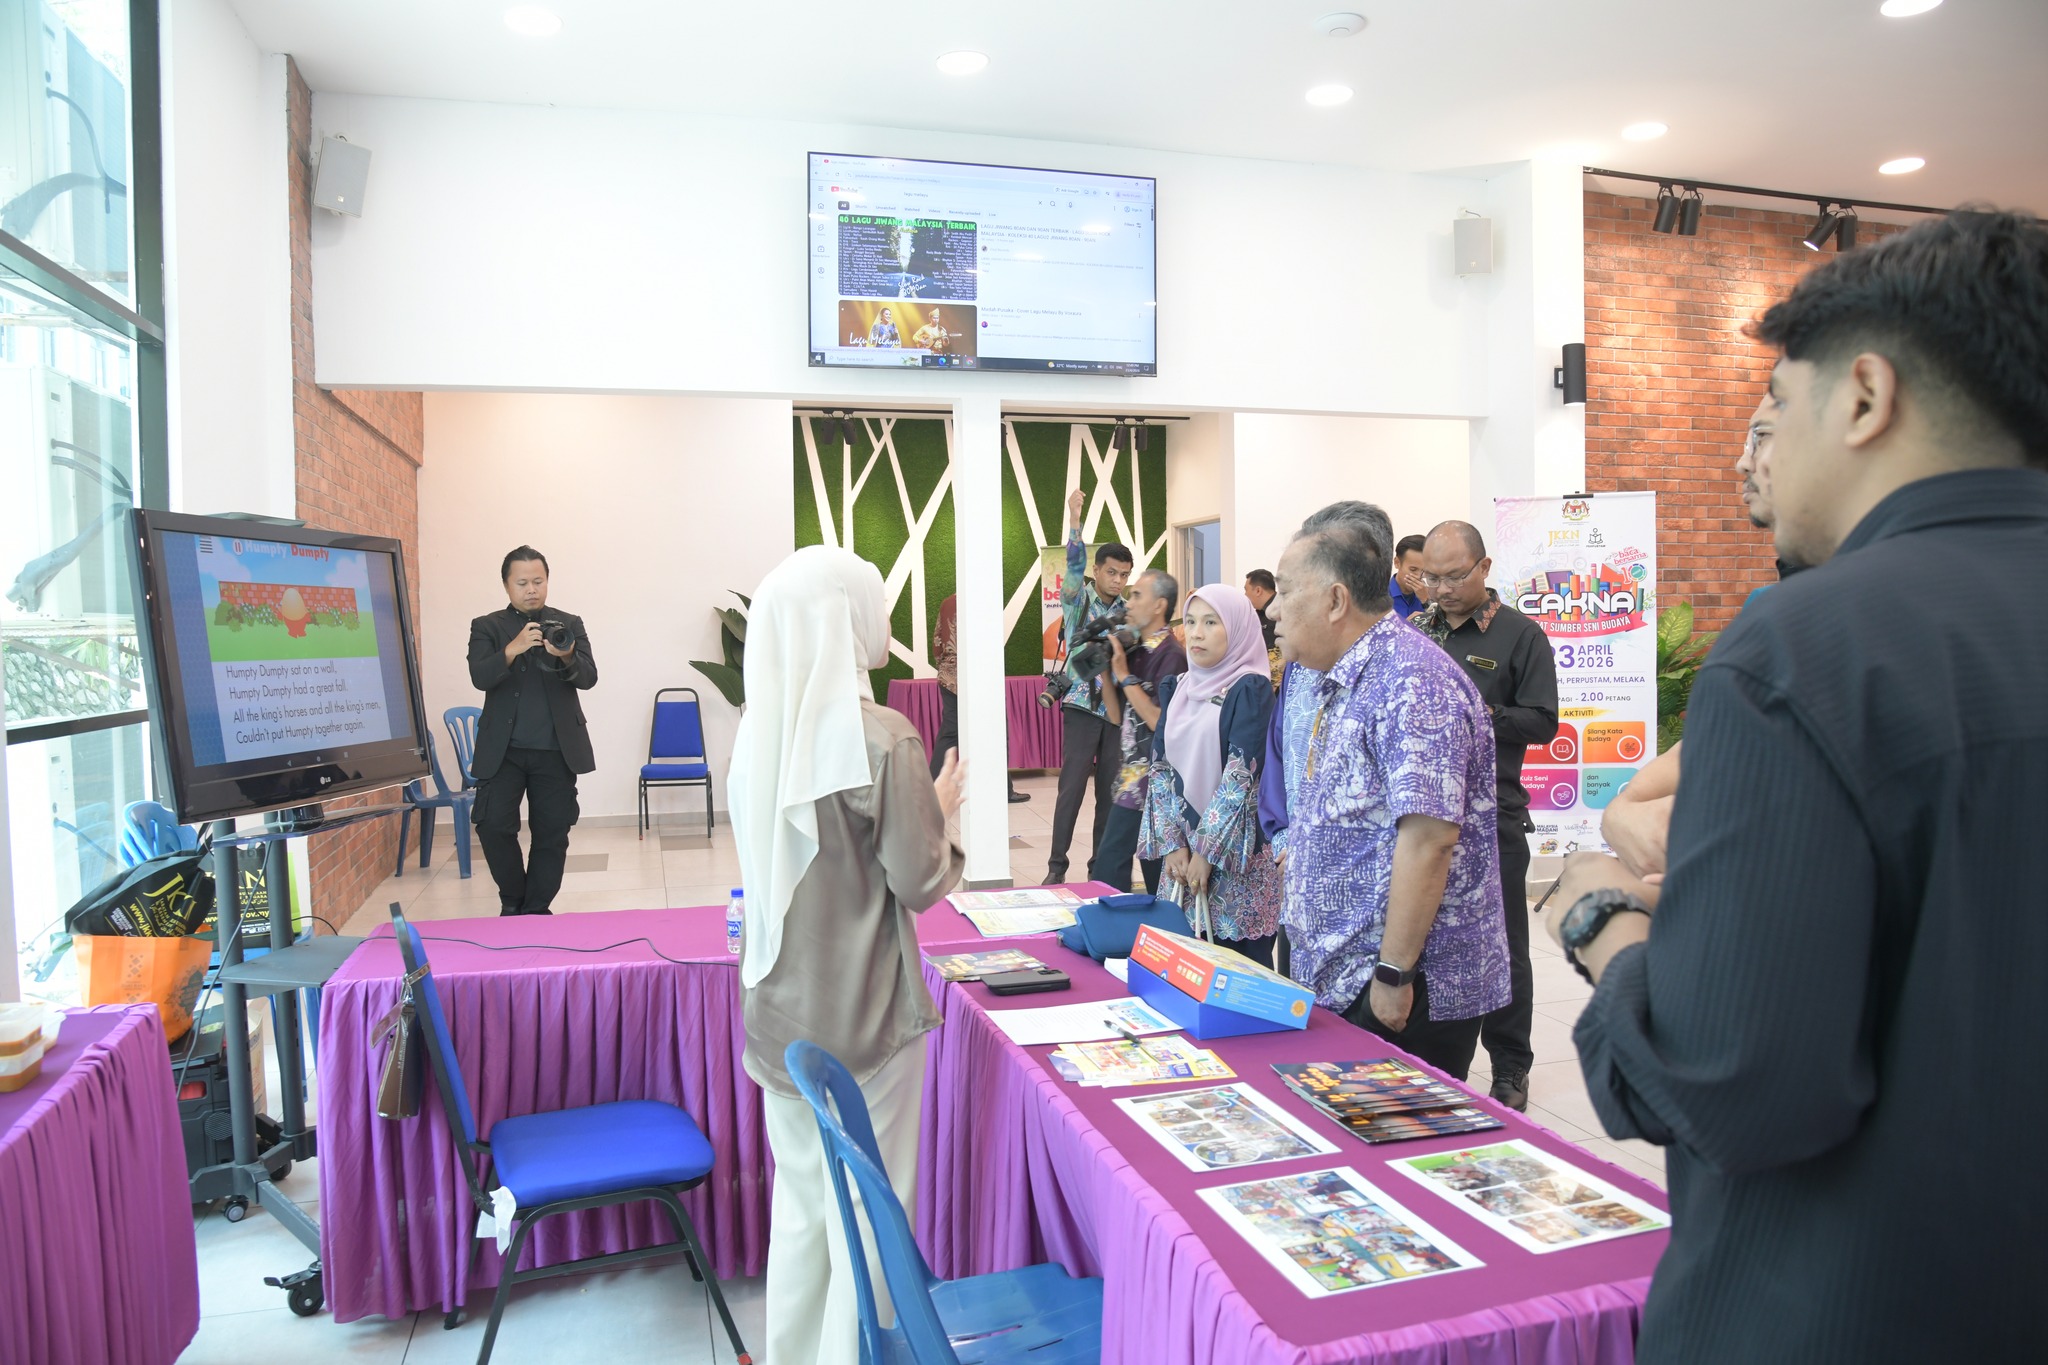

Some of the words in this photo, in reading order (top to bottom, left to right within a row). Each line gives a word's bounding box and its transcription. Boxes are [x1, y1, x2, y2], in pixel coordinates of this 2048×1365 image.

[852, 216, 872, 224] LAGU
[874, 218, 903, 226] JIWANG
[906, 219, 943, 228] MALAYSIA
[946, 222, 976, 230] TERBAIK
[850, 332, 868, 346] Lagu
[870, 332, 902, 348] Melayu
[1548, 530, 1580, 547] JKKN
[245, 540, 287, 558] Humpty
[291, 544, 329, 561] Dumpty
[1614, 552, 1647, 565] bersama
[1618, 548, 1639, 558] baca
[1517, 590, 1636, 616] CAKNA
[1550, 622, 1582, 633] SUMBER
[1583, 622, 1600, 631] SENI
[1602, 616, 1631, 630] BUDAYA
[1578, 645, 1614, 656] APRIL
[226, 666, 257, 680] Humpty
[259, 665, 288, 679] Dumpty
[291, 666, 301, 674] sat
[303, 666, 312, 674] on
[320, 661, 337, 674] wall,
[1578, 657, 1614, 668] 2026
[229, 687, 260, 702] Humpty
[262, 685, 292, 699] Dumpty
[293, 681, 308, 695] had
[316, 683, 334, 696] great
[335, 679, 348, 692] fall.
[1581, 692, 1604, 702] 2.00
[234, 708, 244, 723] All
[247, 708, 259, 722] the
[261, 706, 282, 722] king's
[284, 705, 308, 718] horses
[310, 702, 323, 715] and
[325, 701, 333, 714] all
[335, 700, 345, 712] the
[346, 700, 364, 714] king's
[366, 702, 381, 710] men,
[236, 728, 270, 744] Couldn't
[272, 729, 284, 743] put
[286, 725, 313, 739] Humpty
[315, 721, 342, 737] together
[344, 720, 366, 733] again.
